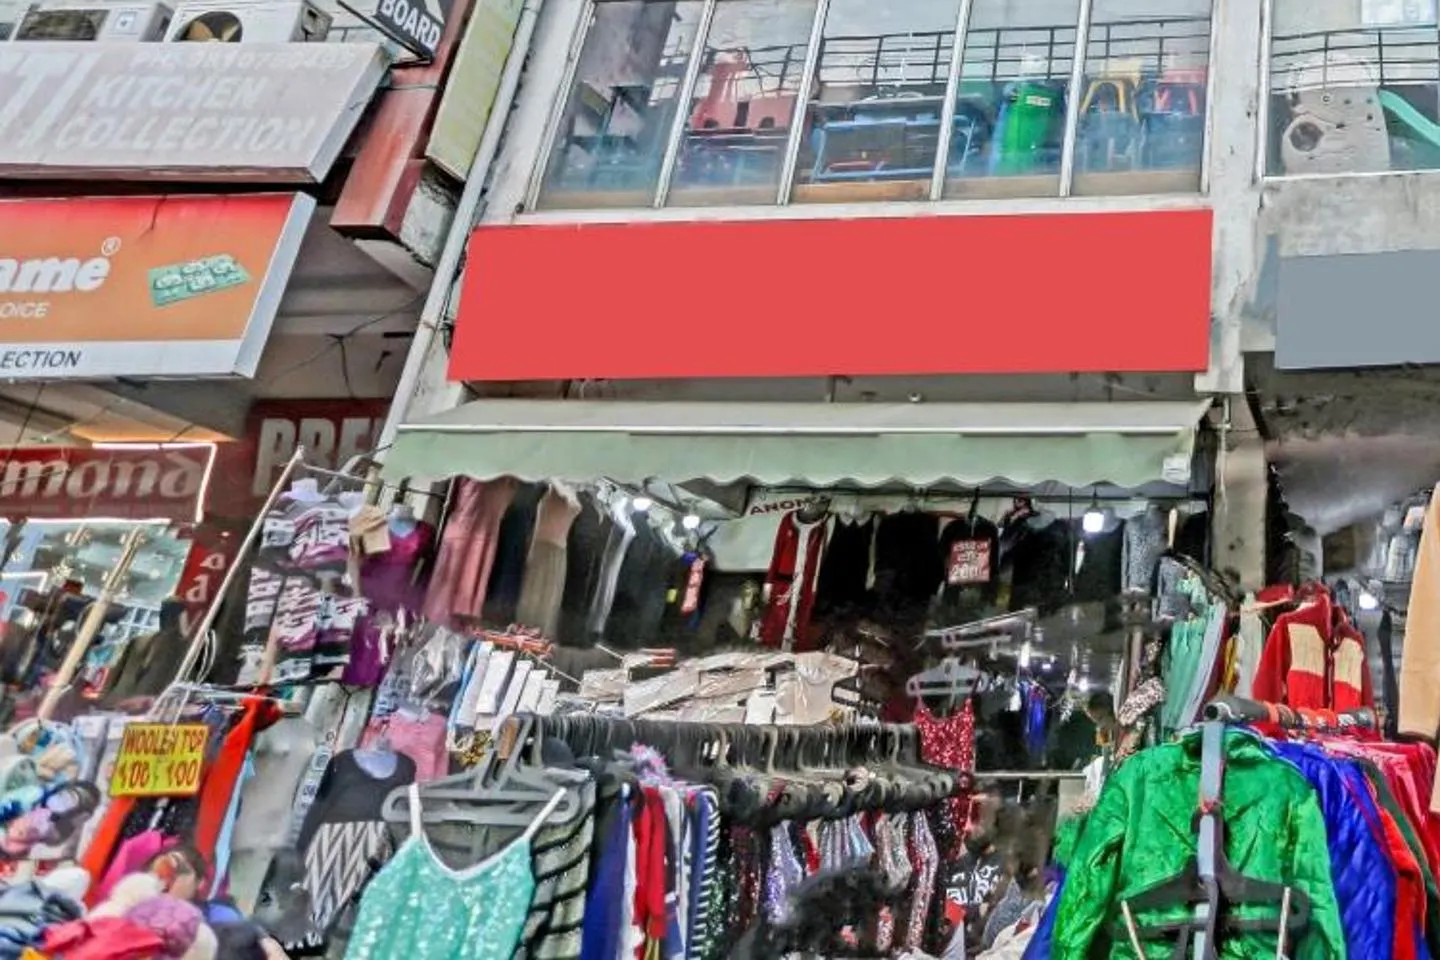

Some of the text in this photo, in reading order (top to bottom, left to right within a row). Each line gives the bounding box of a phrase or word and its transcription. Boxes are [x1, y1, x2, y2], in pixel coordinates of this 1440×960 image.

[83, 74, 269, 111] KITCHEN
[54, 113, 315, 152] COLLECTION
[119, 759, 197, 789] 100 100
